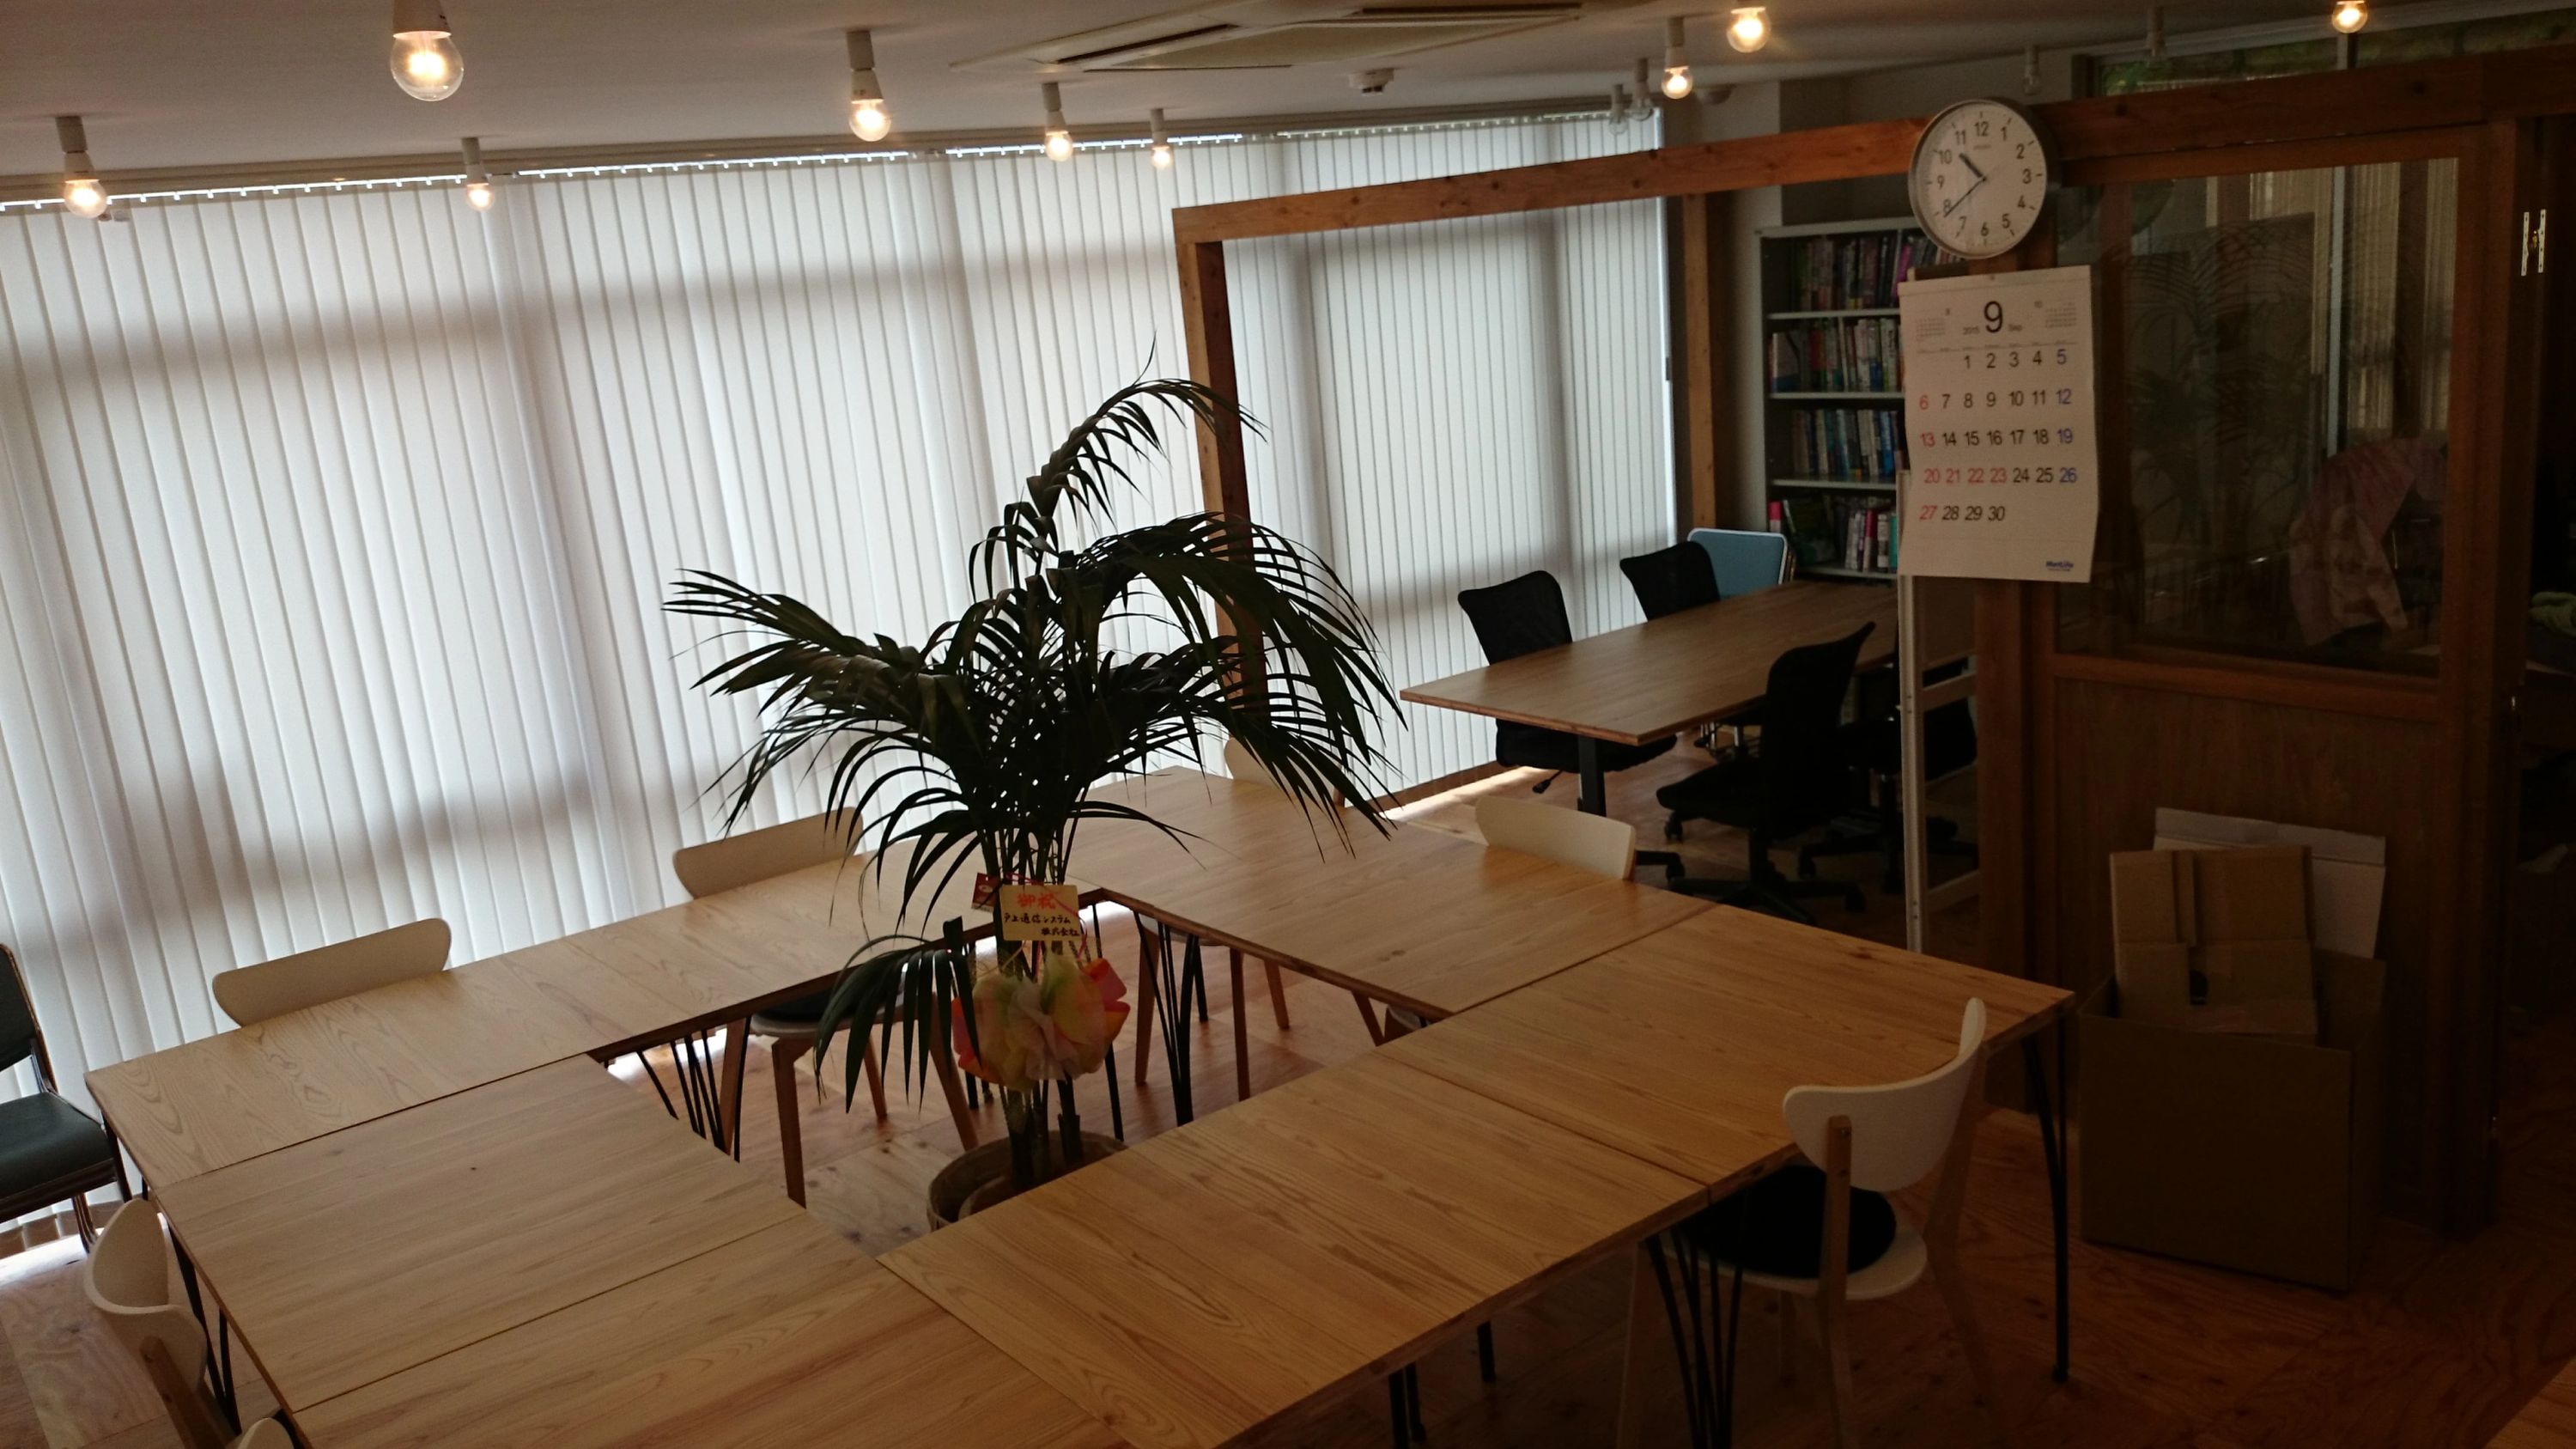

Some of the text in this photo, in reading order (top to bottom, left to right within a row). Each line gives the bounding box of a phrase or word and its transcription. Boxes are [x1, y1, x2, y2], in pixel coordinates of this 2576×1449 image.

[1974, 121, 1990, 137] 12
[2001, 127, 2008, 141] 1
[1954, 131, 1966, 144] 11
[1939, 149, 1953, 164] 10
[2016, 143, 2025, 159] 2
[1937, 175, 1945, 189] 9
[2023, 168, 2032, 184] 3
[1943, 199, 1951, 216] 8
[2018, 196, 2026, 209] 4
[1959, 216, 1966, 229] 7
[2002, 213, 2010, 228] 5
[1981, 222, 1989, 236] 6
[1983, 301, 2004, 333] 9
[1964, 349, 2066, 369] 1 2 3 4 5
[1919, 388, 2071, 411] 6 7 8 9 10 11 12
[1920, 428, 2073, 447] 13 14 15 16 17 18 19
[1924, 467, 2077, 484] 20 21 22 23 24 25 26
[1919, 505, 2005, 521] 27 28 29 30
